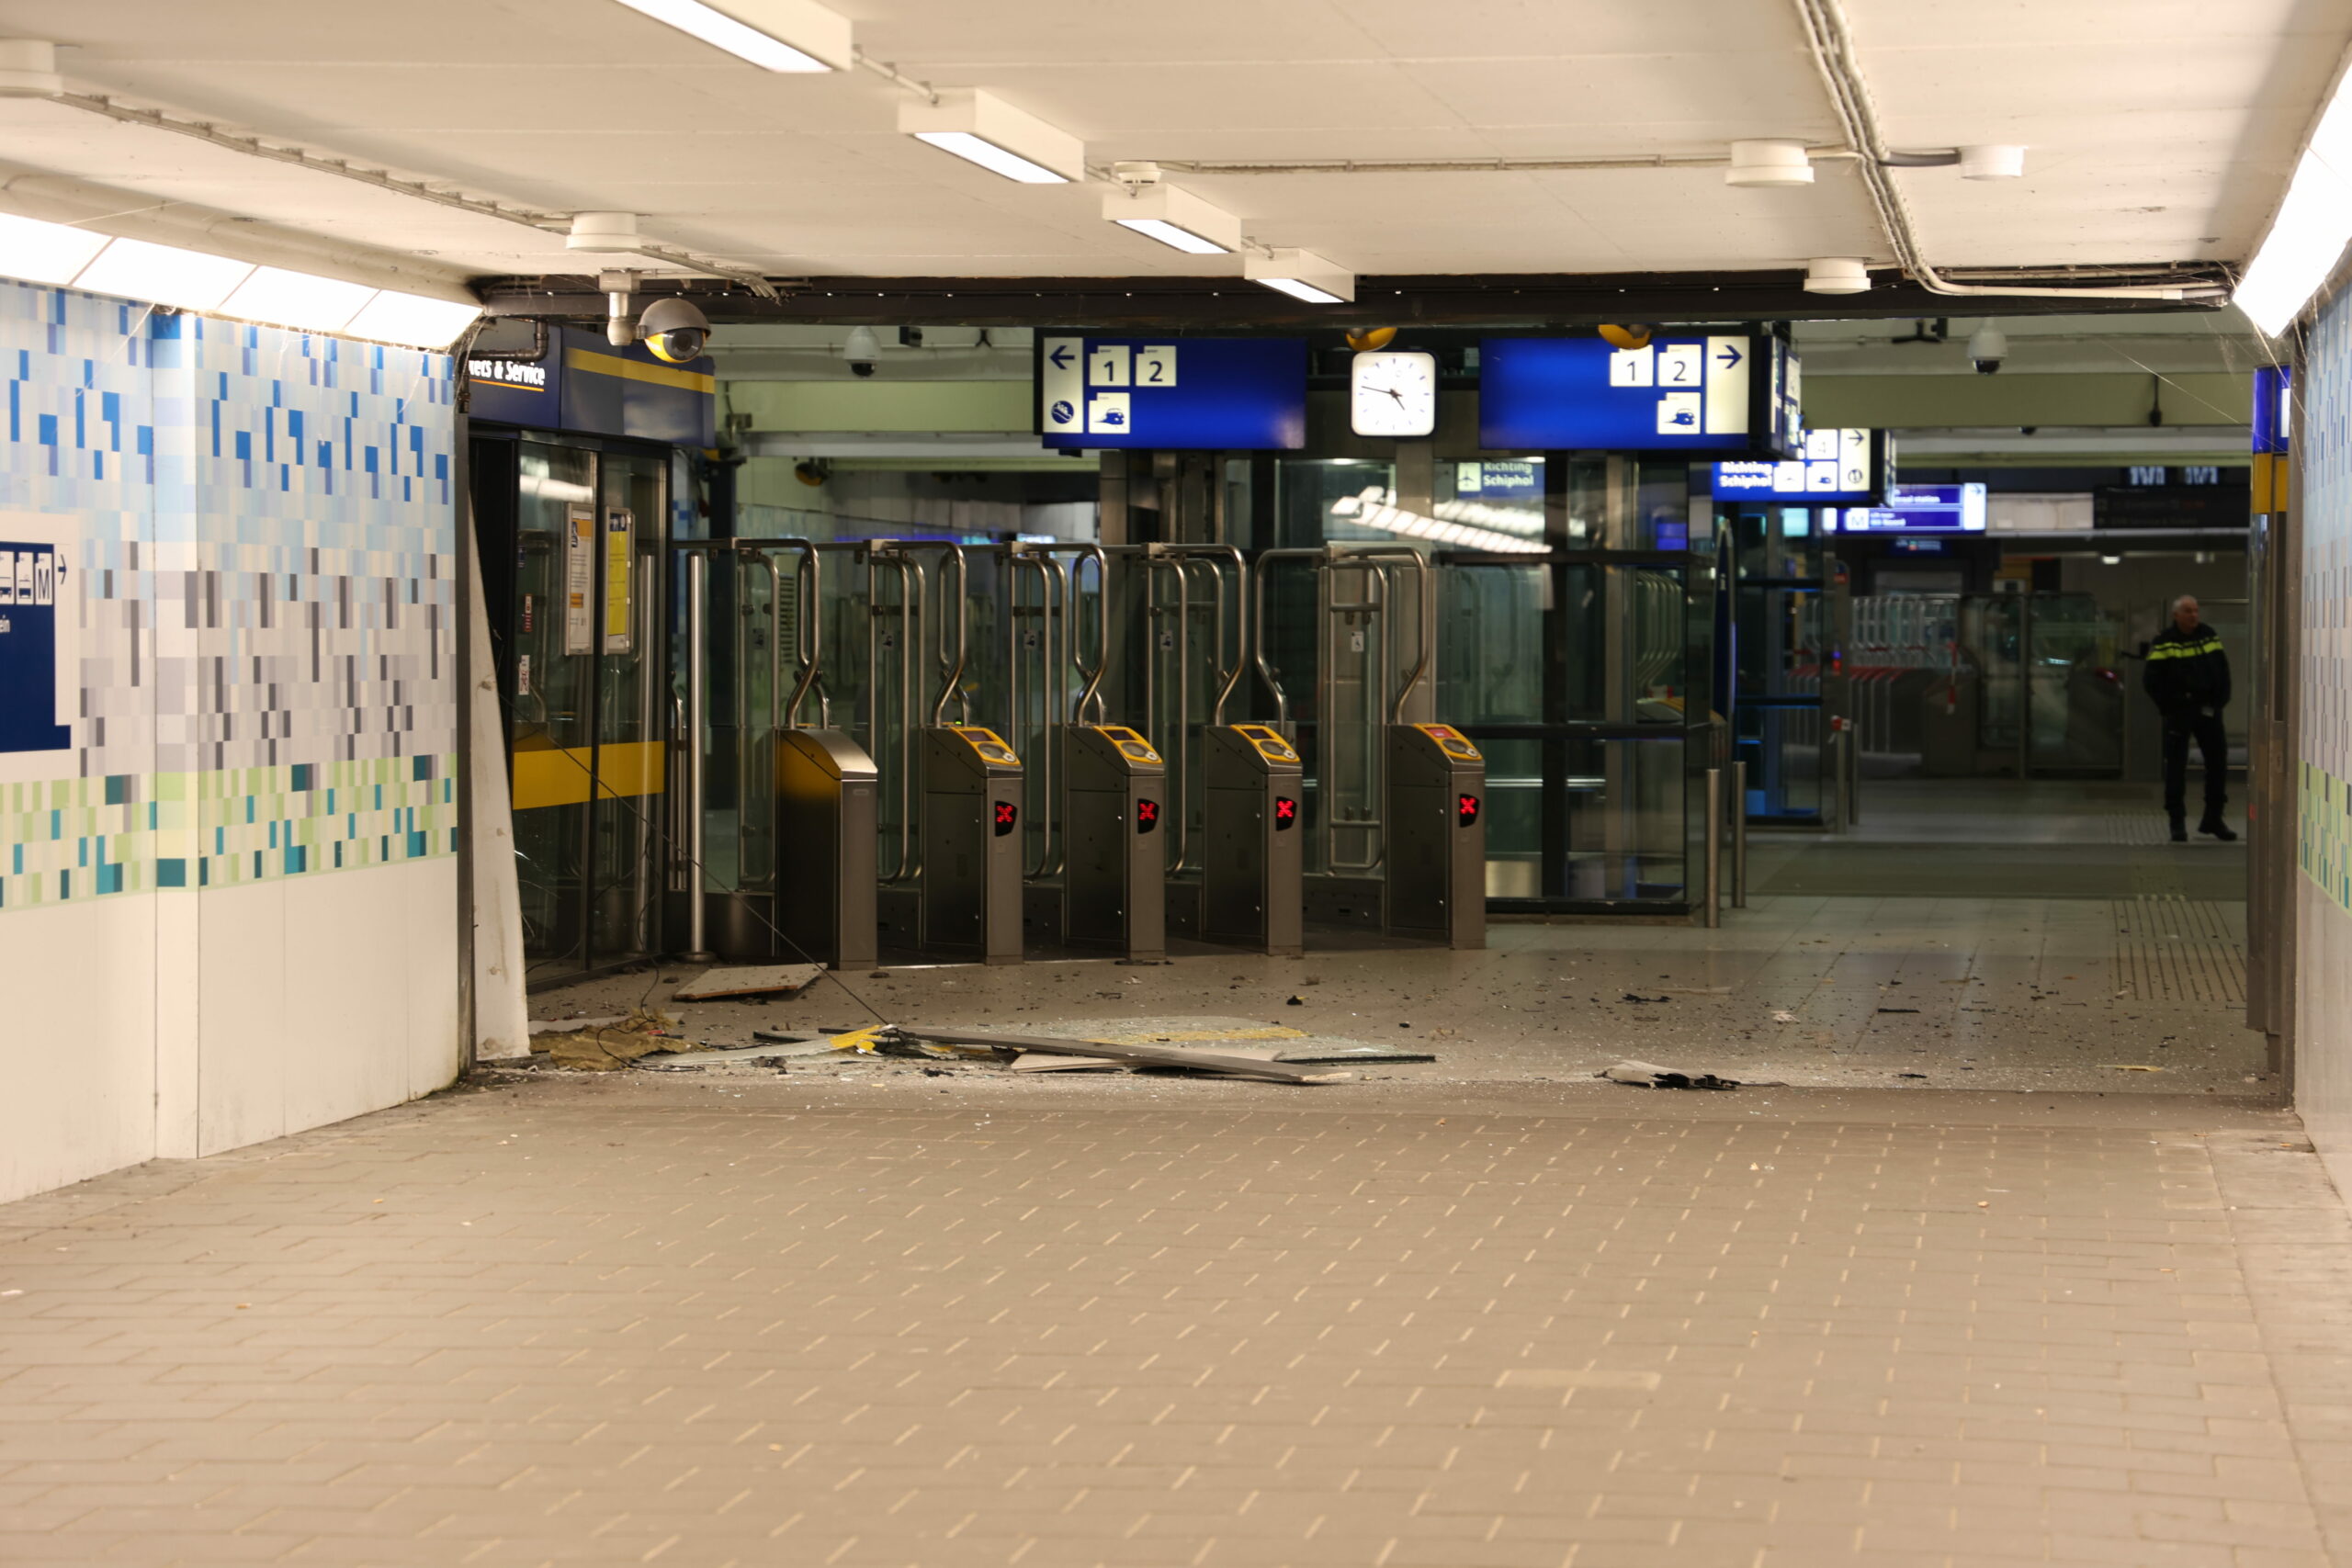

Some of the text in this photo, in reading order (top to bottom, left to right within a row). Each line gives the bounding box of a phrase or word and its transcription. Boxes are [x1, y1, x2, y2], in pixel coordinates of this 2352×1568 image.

[494, 361, 503, 379] &
[505, 361, 545, 386] Service
[1103, 360, 1163, 382] 1 2
[1627, 360, 1687, 381] 1 2
[1721, 461, 1773, 475] Richting
[1483, 474, 1534, 489] Schiphol
[1720, 474, 1773, 489] Schiphol
[1851, 514, 1864, 526] M
[39, 568, 50, 600] M
